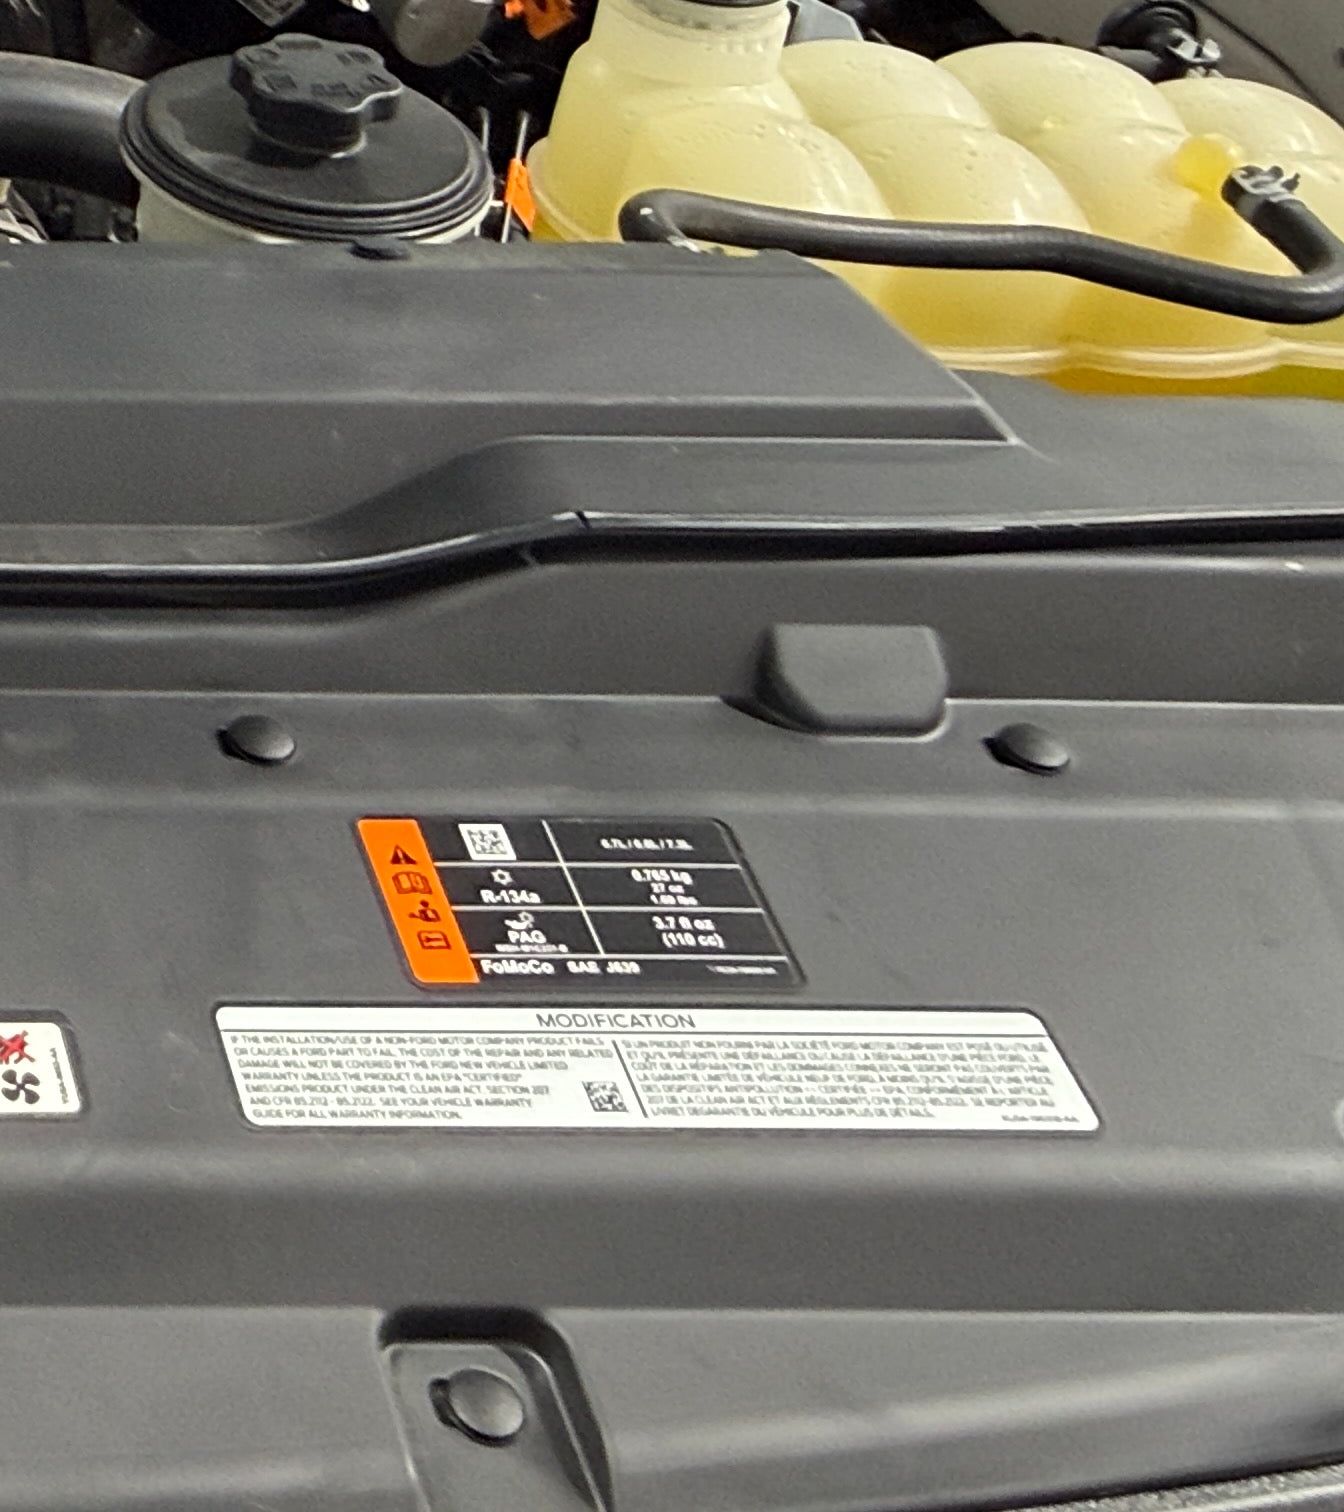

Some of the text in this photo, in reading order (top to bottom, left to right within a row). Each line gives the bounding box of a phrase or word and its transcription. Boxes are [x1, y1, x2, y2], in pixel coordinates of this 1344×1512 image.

[631, 869, 693, 885] 0.765 kg
[480, 889, 541, 903] R-134a
[652, 916, 676, 930] 3.7
[693, 919, 715, 931] oz
[507, 930, 547, 944] PAG
[662, 933, 725, 949] (110 cc)
[480, 960, 555, 974] FoMoCo
[566, 961, 602, 974] SAE
[536, 1013, 696, 1029] MODIFICATION
